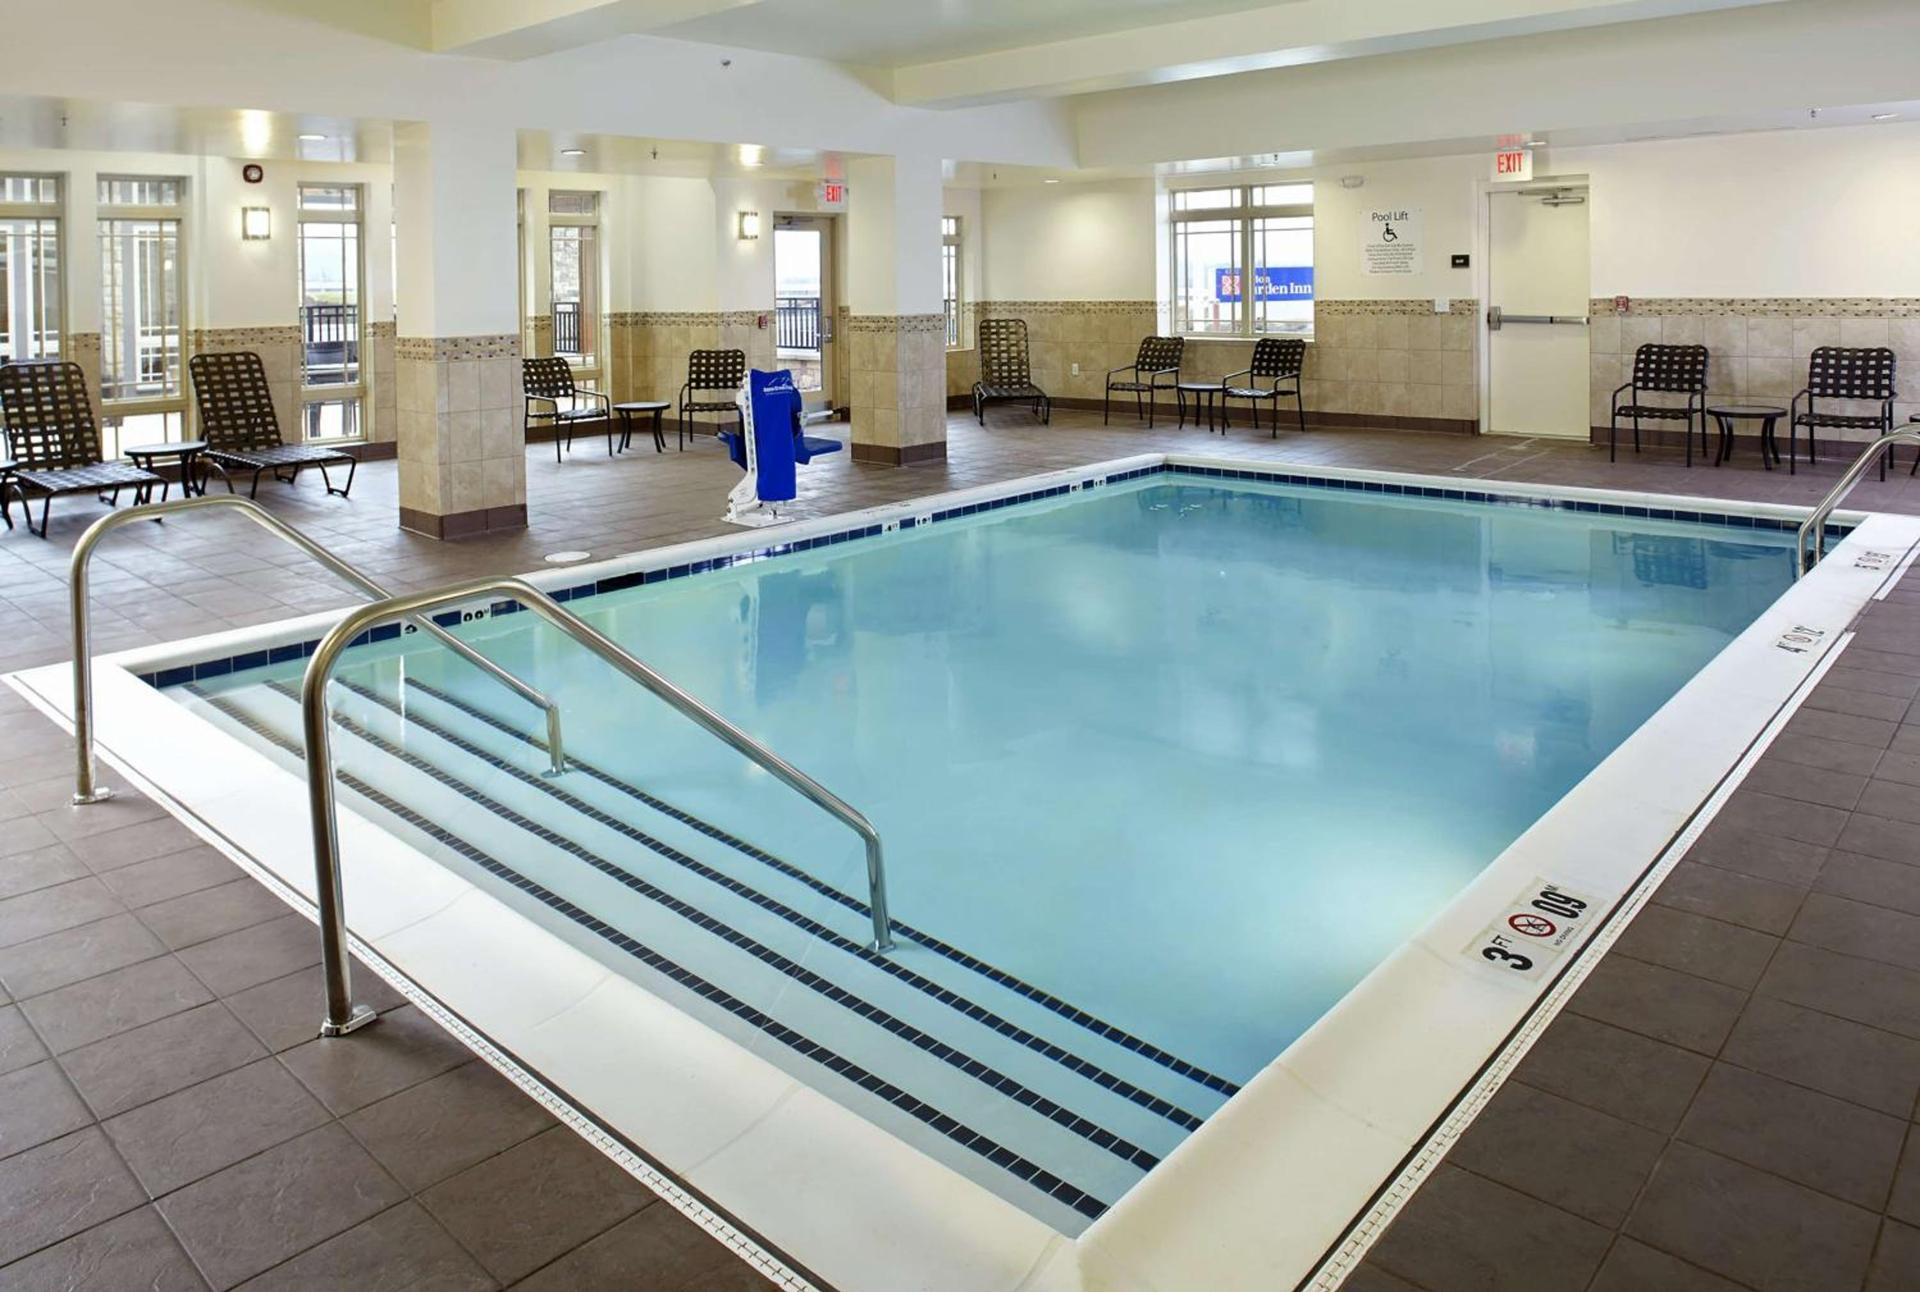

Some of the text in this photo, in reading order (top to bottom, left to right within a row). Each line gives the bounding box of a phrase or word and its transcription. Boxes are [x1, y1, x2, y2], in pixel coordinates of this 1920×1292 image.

[1498, 152, 1523, 173] EXIT
[1372, 211, 1408, 221] Pool Lift
[1290, 282, 1311, 293] Inn
